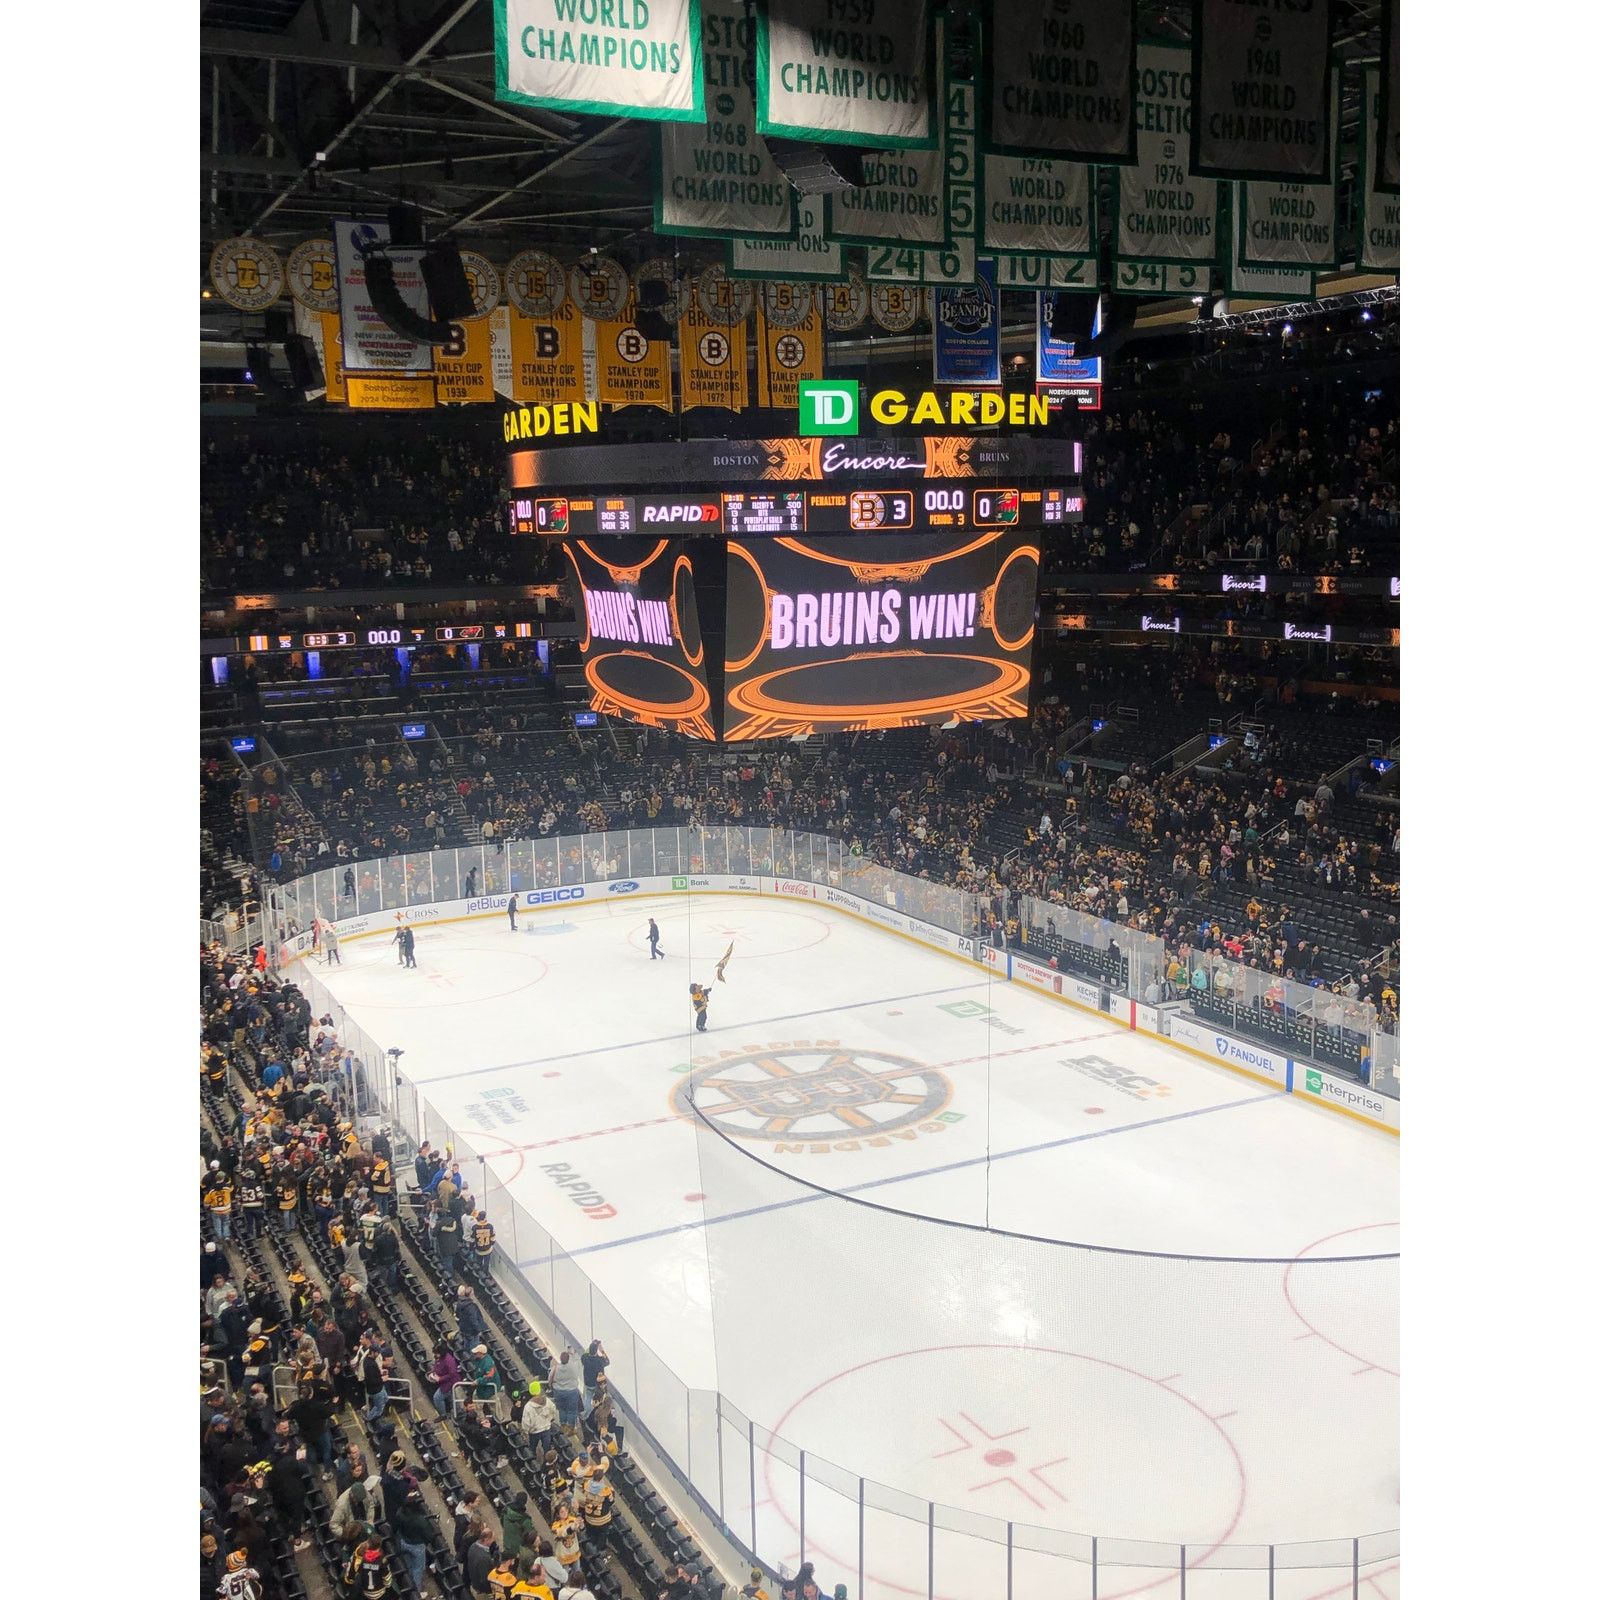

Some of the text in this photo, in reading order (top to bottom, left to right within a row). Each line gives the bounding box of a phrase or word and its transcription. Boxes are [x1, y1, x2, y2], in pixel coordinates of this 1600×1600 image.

[554, 0, 650, 30] WORLD
[1043, 18, 1085, 51] 1960
[520, 25, 681, 75] CHAMPIONS
[811, 30, 894, 64] WORLD
[1028, 51, 1099, 87] WORLD
[780, 62, 919, 105] CHAMPIONS
[1002, 85, 1122, 124] CHAMPIONS
[1231, 80, 1297, 112] WORLD
[707, 121, 747, 147] 1968
[1208, 112, 1318, 145] CHAMPIONS
[695, 148, 762, 176] WORLD
[863, 163, 918, 188] WORLD
[1154, 163, 1184, 186] 1976
[671, 175, 783, 207] CHAMPIONS
[1009, 176, 1066, 200] WORLD
[1144, 188, 1195, 211] WORLD
[841, 190, 938, 217] CHAMPIONS
[991, 201, 1083, 228] CHAMPIONS
[1268, 196, 1316, 219] WORLD
[1125, 213, 1212, 237] CHAMPIONS
[1251, 219, 1330, 244] CHAMPIONS
[869, 246, 918, 277] 24
[939, 242, 961, 278] 6
[1009, 257, 1041, 282] 10
[1064, 259, 1086, 284] 2
[529, 277, 544, 294] 15
[779, 289, 790, 306] 5
[837, 291, 848, 308] 4
[890, 292, 901, 309] 3
[938, 301, 996, 325] BEANPOT
[521, 363, 575, 375] STANLEY CUP
[607, 365, 660, 379] STANLEY CUP
[690, 369, 724, 380] STANLEY
[767, 371, 799, 382] TANLEY
[521, 375, 577, 387] CHAMPIONS
[607, 377, 661, 391] CHAMPIONS
[690, 381, 740, 392] CHAMPIONS
[707, 392, 726, 403] 1972
[804, 389, 1049, 426] TD GARDEN
[503, 400, 599, 443] GARDEN
[712, 454, 760, 466] BOSTON
[822, 442, 928, 473] Encore
[978, 452, 1010, 462] BRUINS
[810, 495, 847, 507] PENALTIES
[893, 499, 906, 520] 3
[924, 490, 964, 511] 00.0
[979, 498, 991, 518] 0
[538, 506, 547, 526] 0
[601, 511, 630, 520] BOS 35
[601, 521, 630, 530] MIN 34
[957, 513, 965, 526] 3
[1225, 575, 1261, 591] Encore
[585, 589, 673, 647] BRUINS WIN!
[770, 588, 977, 650] BRUINS WIN!
[1144, 615, 1177, 631] Encore
[337, 633, 347, 645] 3
[367, 630, 401, 645] 00.0
[1287, 623, 1328, 641] Encore
[526, 886, 586, 906] GEICO
[609, 880, 639, 895] Ford
[465, 897, 508, 915] jetBlue
[1230, 1046, 1275, 1072] FANDUEL
[1309, 1075, 1383, 1113] enterprise
